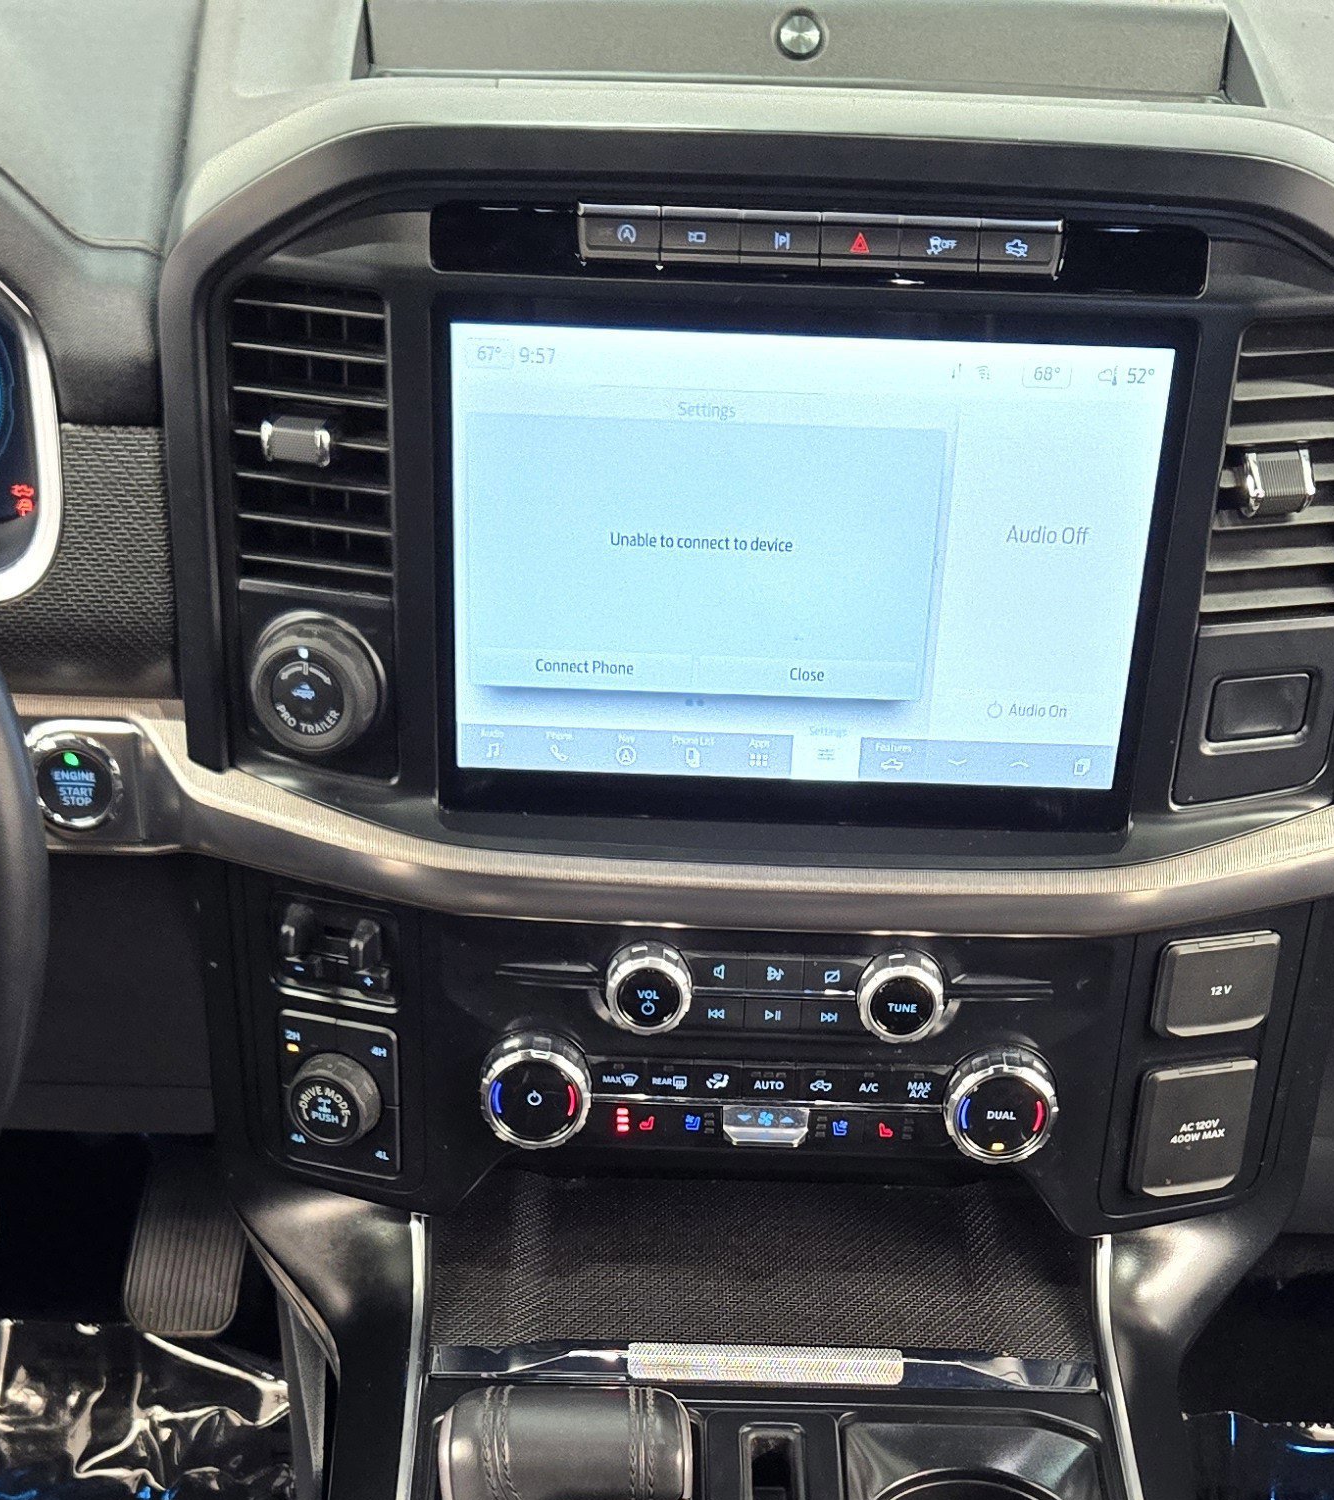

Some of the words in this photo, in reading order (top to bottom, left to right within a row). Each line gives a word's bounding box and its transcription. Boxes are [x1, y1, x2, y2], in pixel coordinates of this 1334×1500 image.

[518, 346, 556, 364] 9:57
[1033, 366, 1061, 381] 68°
[1127, 367, 1155, 384] 52°
[677, 402, 737, 421] Settings
[1006, 524, 1058, 545] Audio
[1061, 526, 1091, 546] Off
[609, 532, 657, 549] Unable
[660, 534, 675, 549] to
[676, 535, 731, 552] connect
[733, 536, 748, 552] to
[750, 537, 794, 553] device
[535, 658, 589, 674] Connect
[592, 660, 634, 676] Phone
[789, 667, 825, 682] Close
[1009, 703, 1047, 718] Audio
[1049, 704, 1068, 718] On
[275, 703, 297, 727] PRO
[298, 708, 341, 735] TRAILER
[52, 769, 97, 784] ENGINE
[58, 785, 95, 798] START
[62, 795, 93, 808] STOP
[636, 989, 660, 1000] VOL
[887, 1002, 918, 1014] TUNE
[284, 1029, 301, 1041] 2H
[370, 1045, 388, 1058] 4H
[602, 1075, 621, 1085] MAX
[651, 1077, 673, 1086] REAR
[753, 1080, 785, 1091] AUTO
[907, 1081, 932, 1091] MAX
[858, 1082, 879, 1094] A/C
[908, 1089, 930, 1099] A/C
[298, 1086, 324, 1111] DRIVE
[324, 1086, 352, 1117] MODE
[310, 1111, 340, 1125] PUSH
[986, 1110, 1017, 1121] DUAL
[1179, 1122, 1195, 1133] AC
[1195, 1118, 1220, 1131] 120V
[1169, 1131, 1201, 1144] 400W
[1202, 1128, 1226, 1141] MAX
[374, 1150, 390, 1161] 4L
